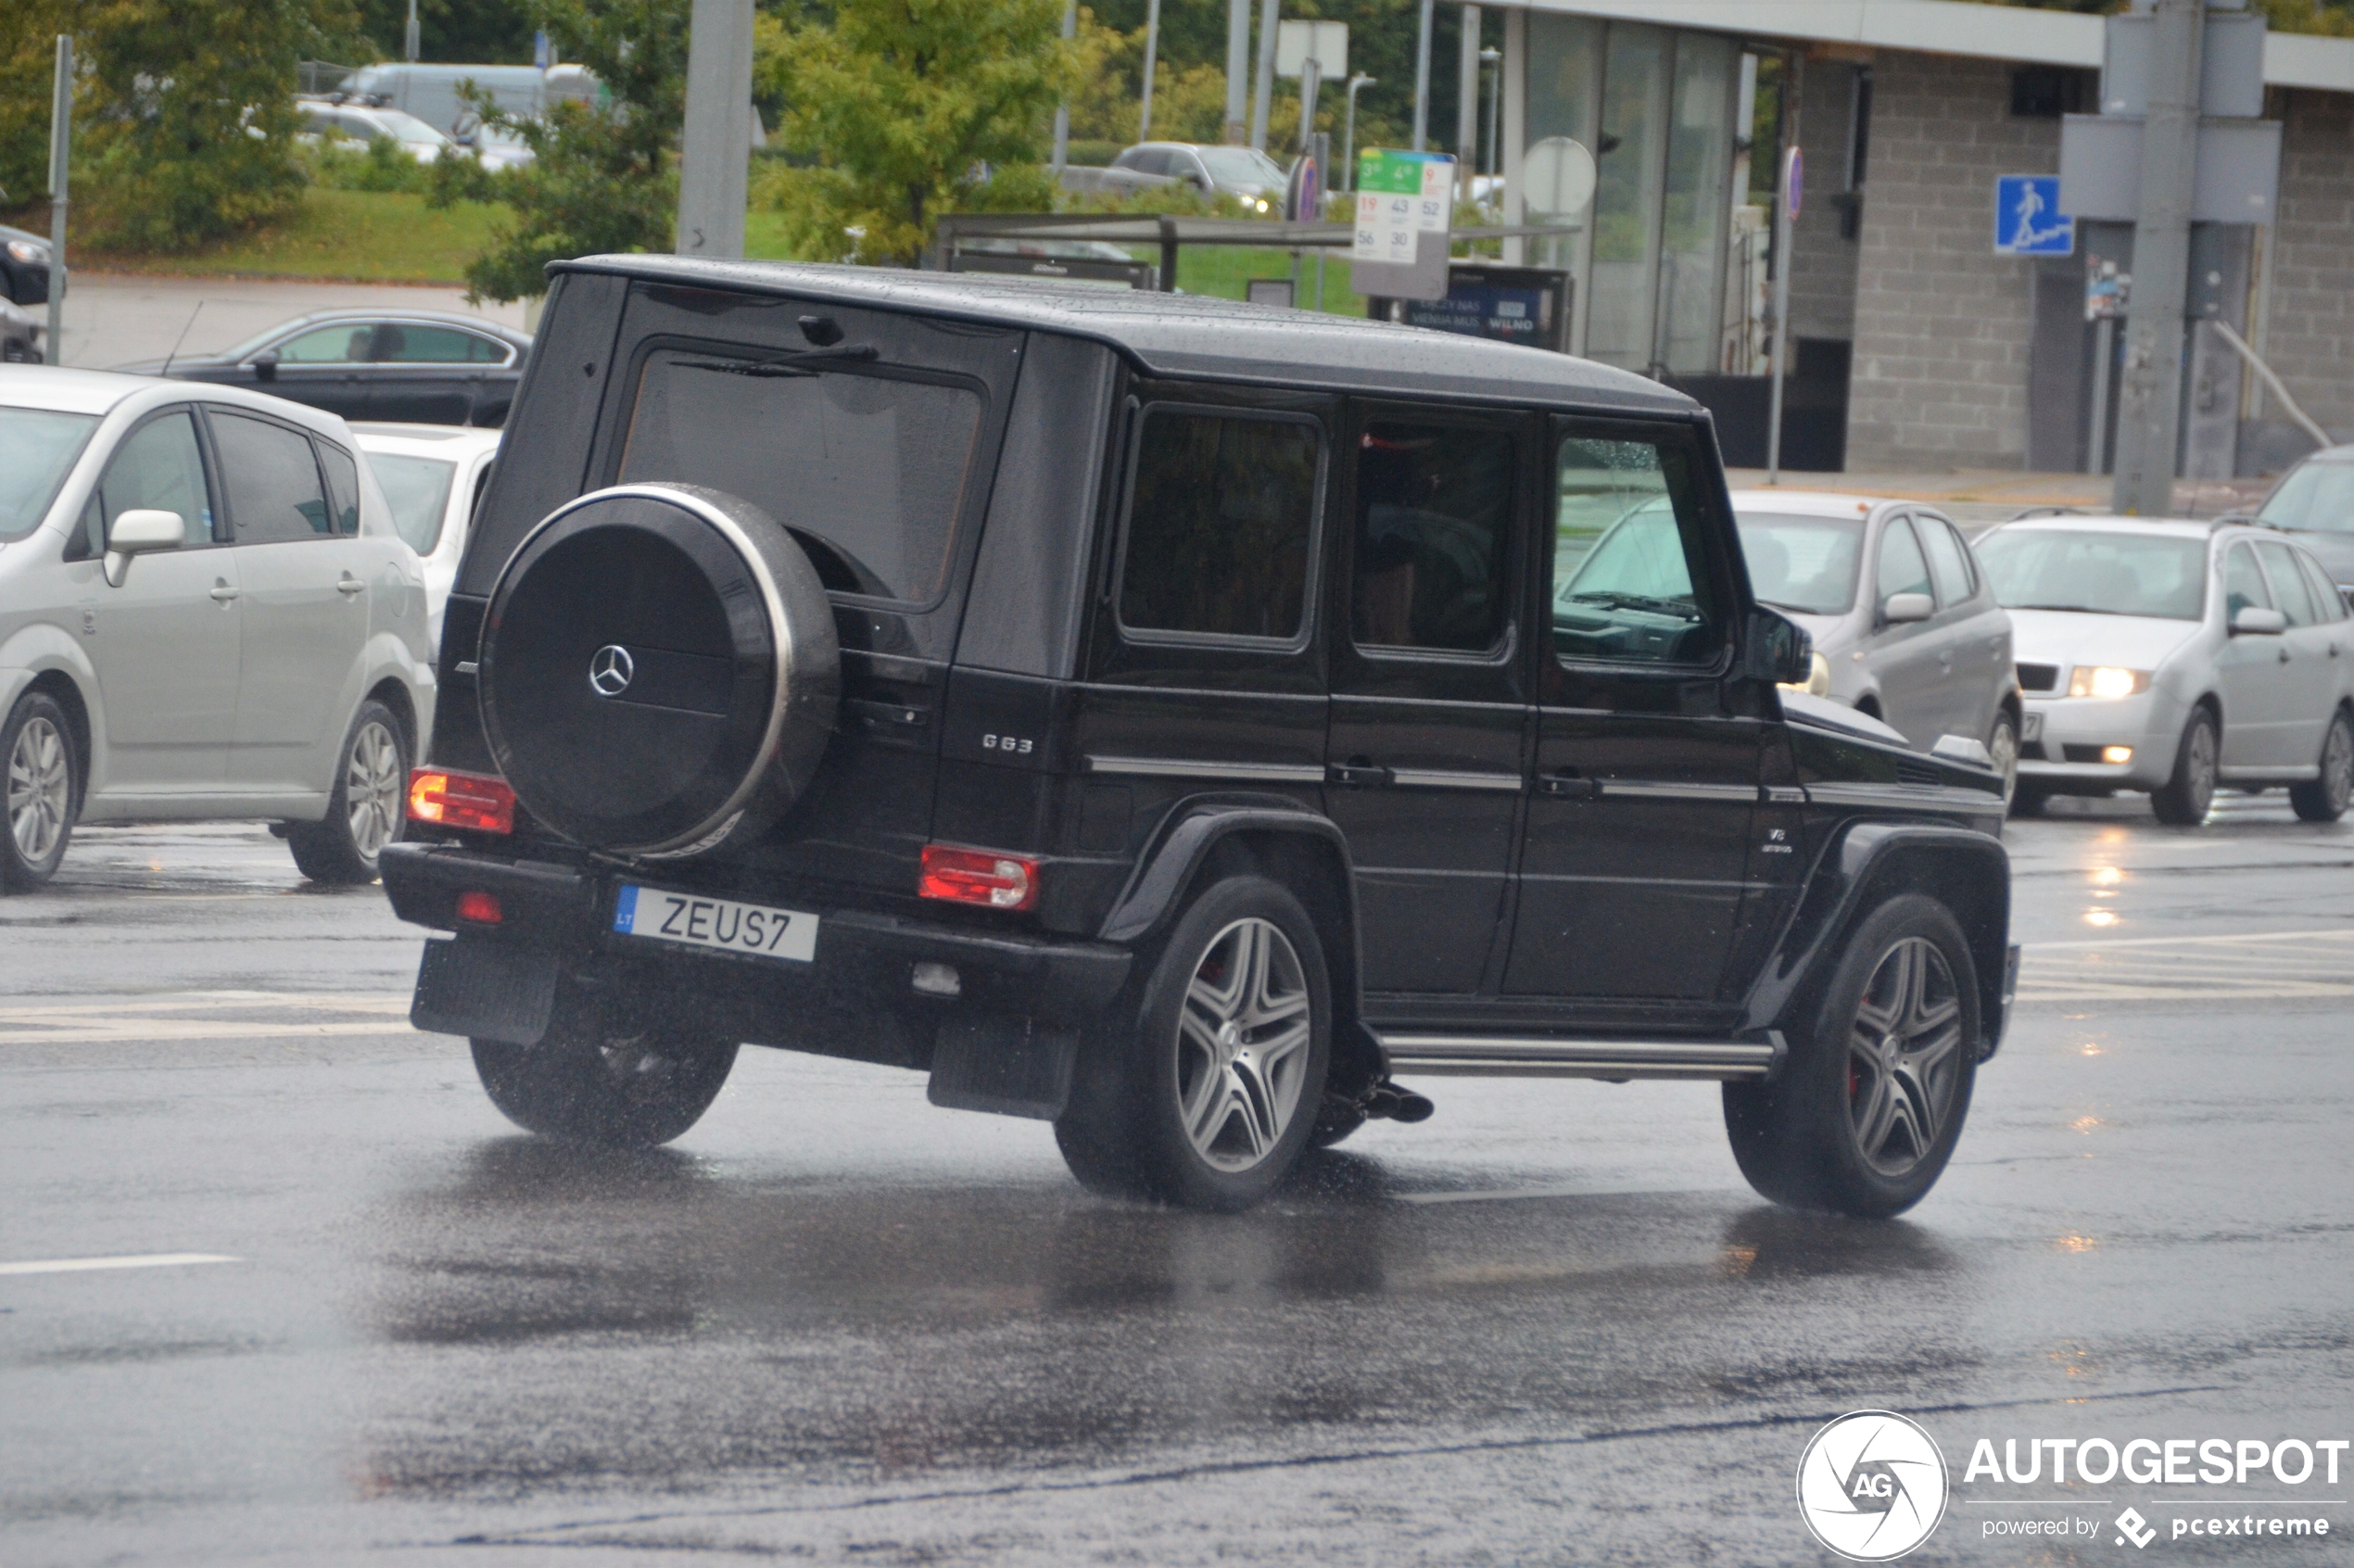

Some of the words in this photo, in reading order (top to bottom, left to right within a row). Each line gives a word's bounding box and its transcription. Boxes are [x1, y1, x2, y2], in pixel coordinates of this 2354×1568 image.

[1425, 169, 1435, 181] 9
[1361, 196, 1377, 210] 19
[1392, 198, 1409, 213] 43
[1423, 201, 1439, 216] 52
[1358, 230, 1373, 245] 56
[1391, 232, 1408, 246] 30
[1488, 317, 1534, 332] WILNO
[616, 913, 633, 926] LT
[660, 897, 791, 951] ZEUS7
